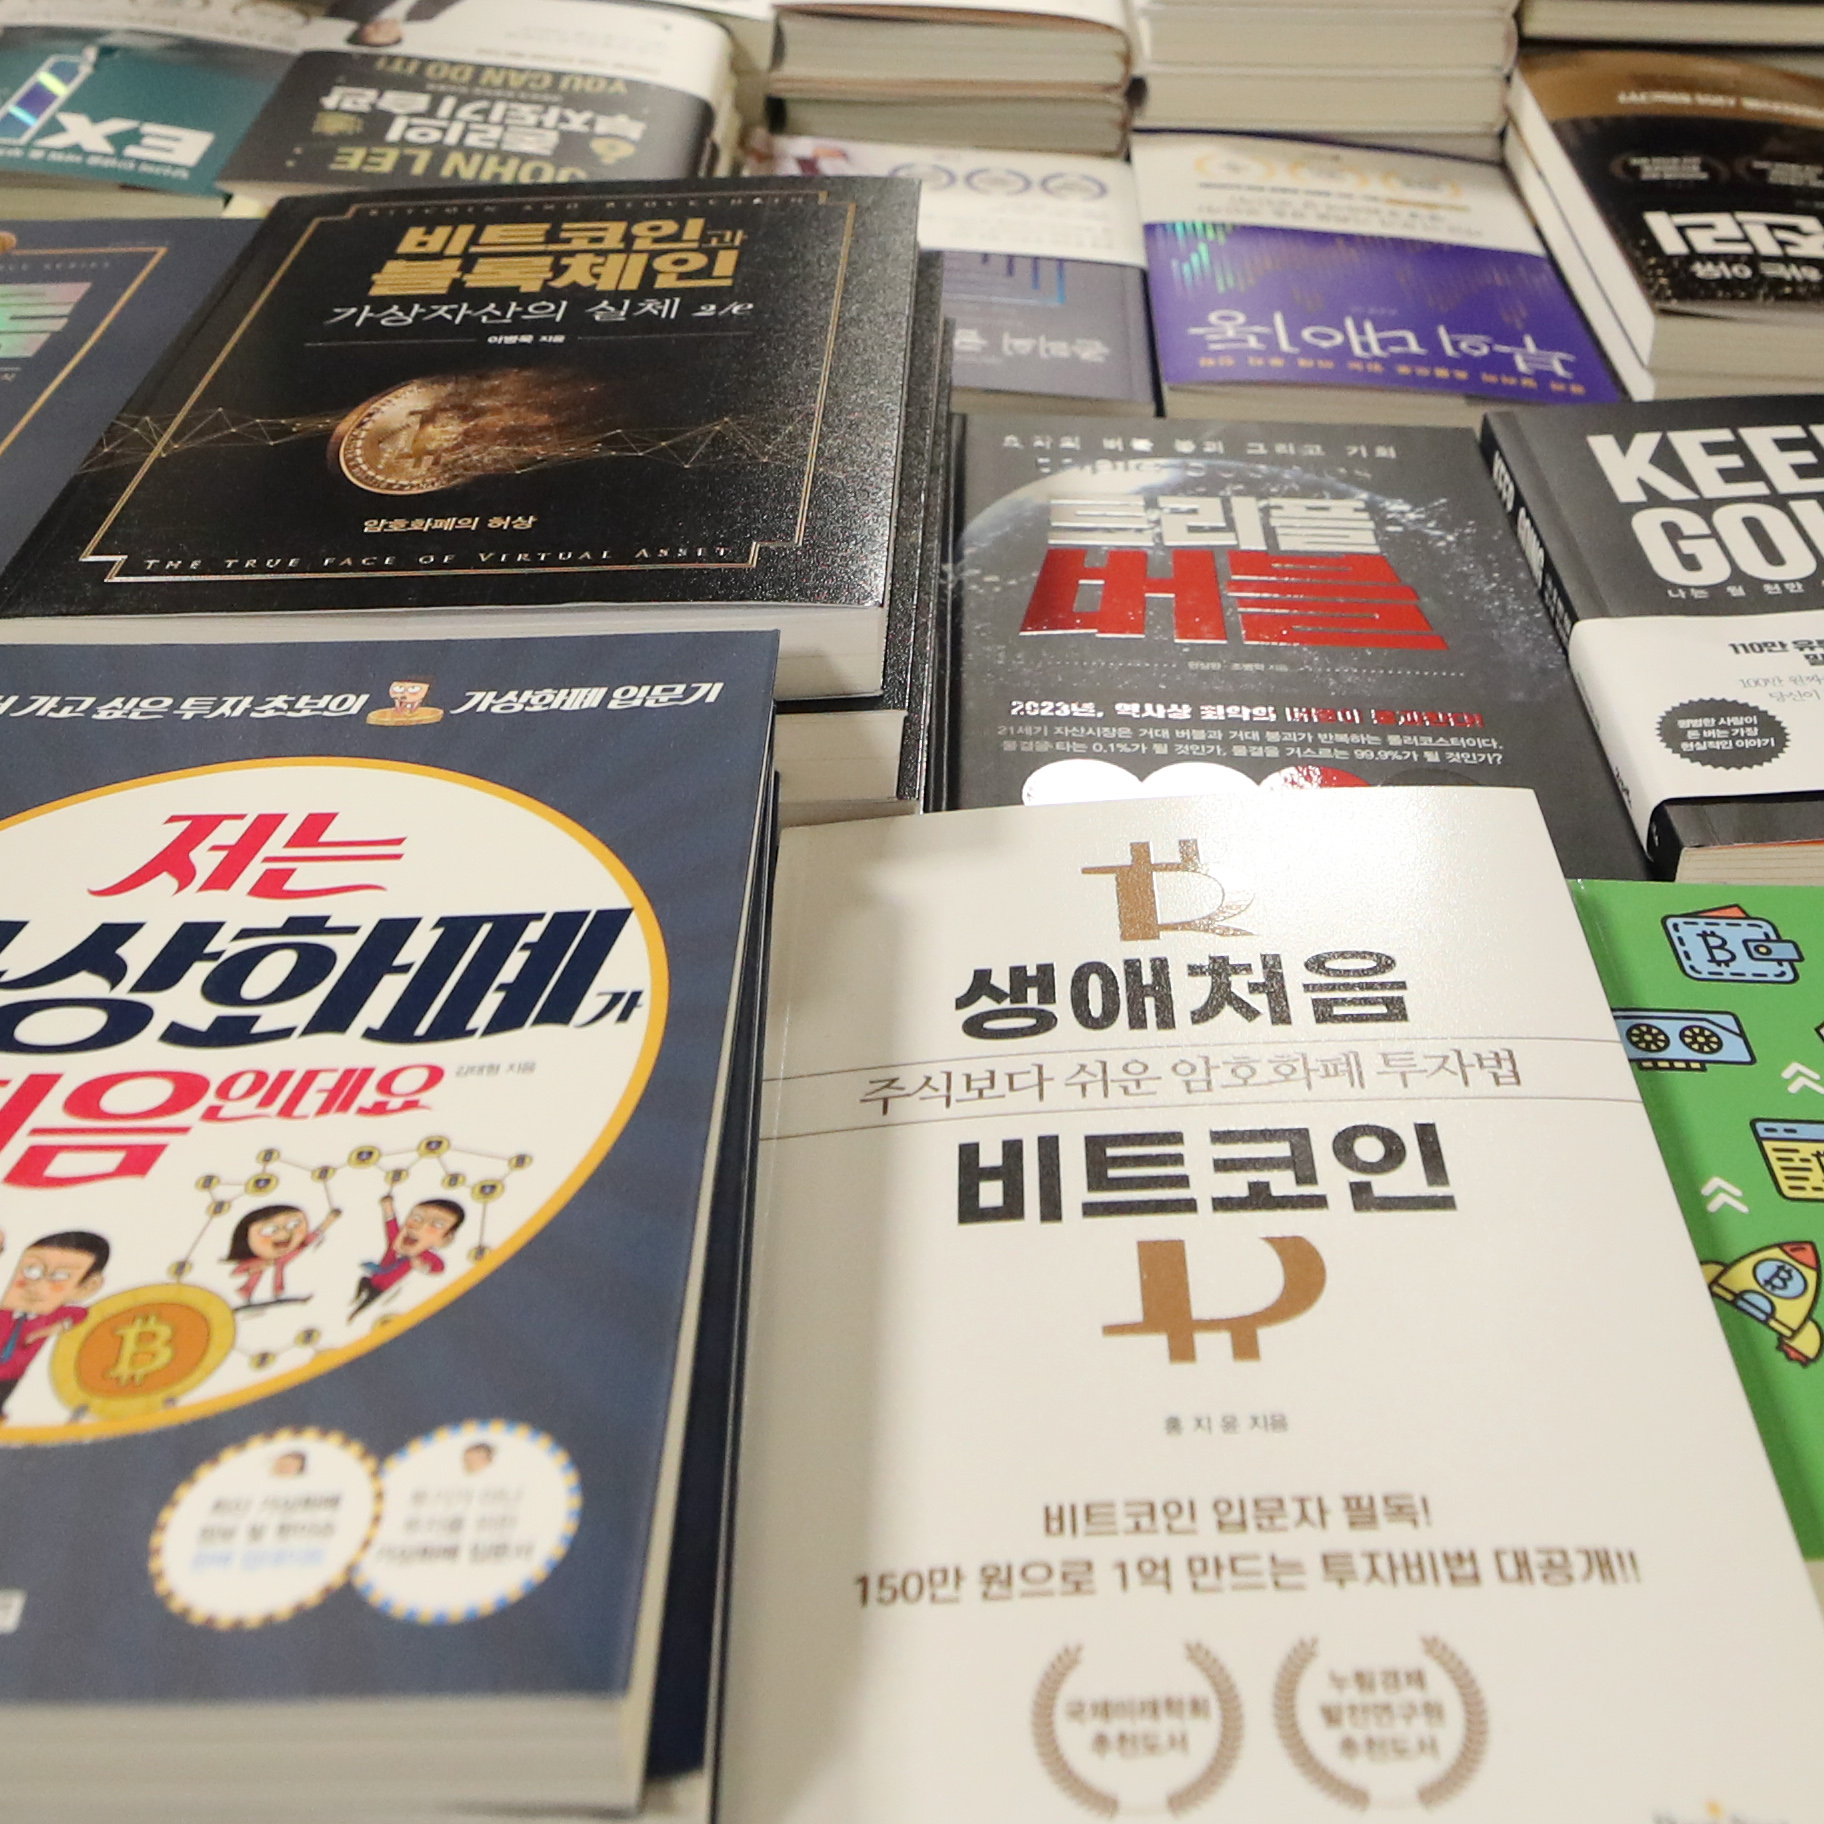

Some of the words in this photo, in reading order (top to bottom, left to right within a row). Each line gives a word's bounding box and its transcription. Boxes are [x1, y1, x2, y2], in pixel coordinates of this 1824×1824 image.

[384, 114, 560, 157] 존리의
[367, 249, 739, 297] 블록체인
[323, 300, 566, 328] 가상자산의
[585, 296, 680, 321] 실체
[692, 301, 754, 317] 2/e
[1186, 307, 1424, 360] 대이동
[1437, 324, 1576, 378] 부의
[362, 516, 478, 534] 암호화폐의
[486, 514, 538, 530] 허상
[1047, 496, 1381, 554] 트리플
[144, 558, 204, 571] THE
[224, 557, 301, 570] TRUE
[323, 556, 397, 568] FACE
[419, 554, 457, 565] OF
[478, 550, 612, 564] VIRTUAL
[634, 546, 732, 559] ASSET
[1019, 547, 1448, 651] 버블
[32, 694, 92, 720] 가고
[94, 694, 172, 724] 싶은
[174, 693, 250, 721] 투자
[252, 692, 369, 721] 초보의
[450, 685, 601, 717] 가상화폐
[608, 680, 724, 714] 입문기
[1718, 715, 1758, 726] 사람이
[1680, 739, 1733, 752] 현실적인
[1735, 737, 1776, 748] 이야기
[1702, 728, 1729, 738] 버는
[1731, 727, 1758, 737] 가장
[89, 811, 408, 900] 저는
[955, 949, 1410, 1042] 생애처음
[859, 1061, 1054, 1116] 주식보다
[1064, 1055, 1162, 1101] 쉬운
[1171, 1049, 1367, 1097] 암호화폐
[1376, 1046, 1523, 1091] 투자법
[956, 1121, 1459, 1226] 비트코인
[1044, 1499, 1198, 1538] 비트코인
[1212, 1495, 1329, 1535] 입문자
[1342, 1492, 1433, 1530] 필독!
[854, 1566, 966, 1610] 150만
[979, 1561, 1097, 1603] 원으로
[1111, 1557, 1173, 1595] 1억
[1187, 1553, 1308, 1595] 만드는
[1320, 1549, 1483, 1591] 투자비법
[1493, 1545, 1641, 1587] 대공개!!
[1091, 1732, 1190, 1759] 추천도서
[1338, 1734, 1440, 1762] 추천도서
